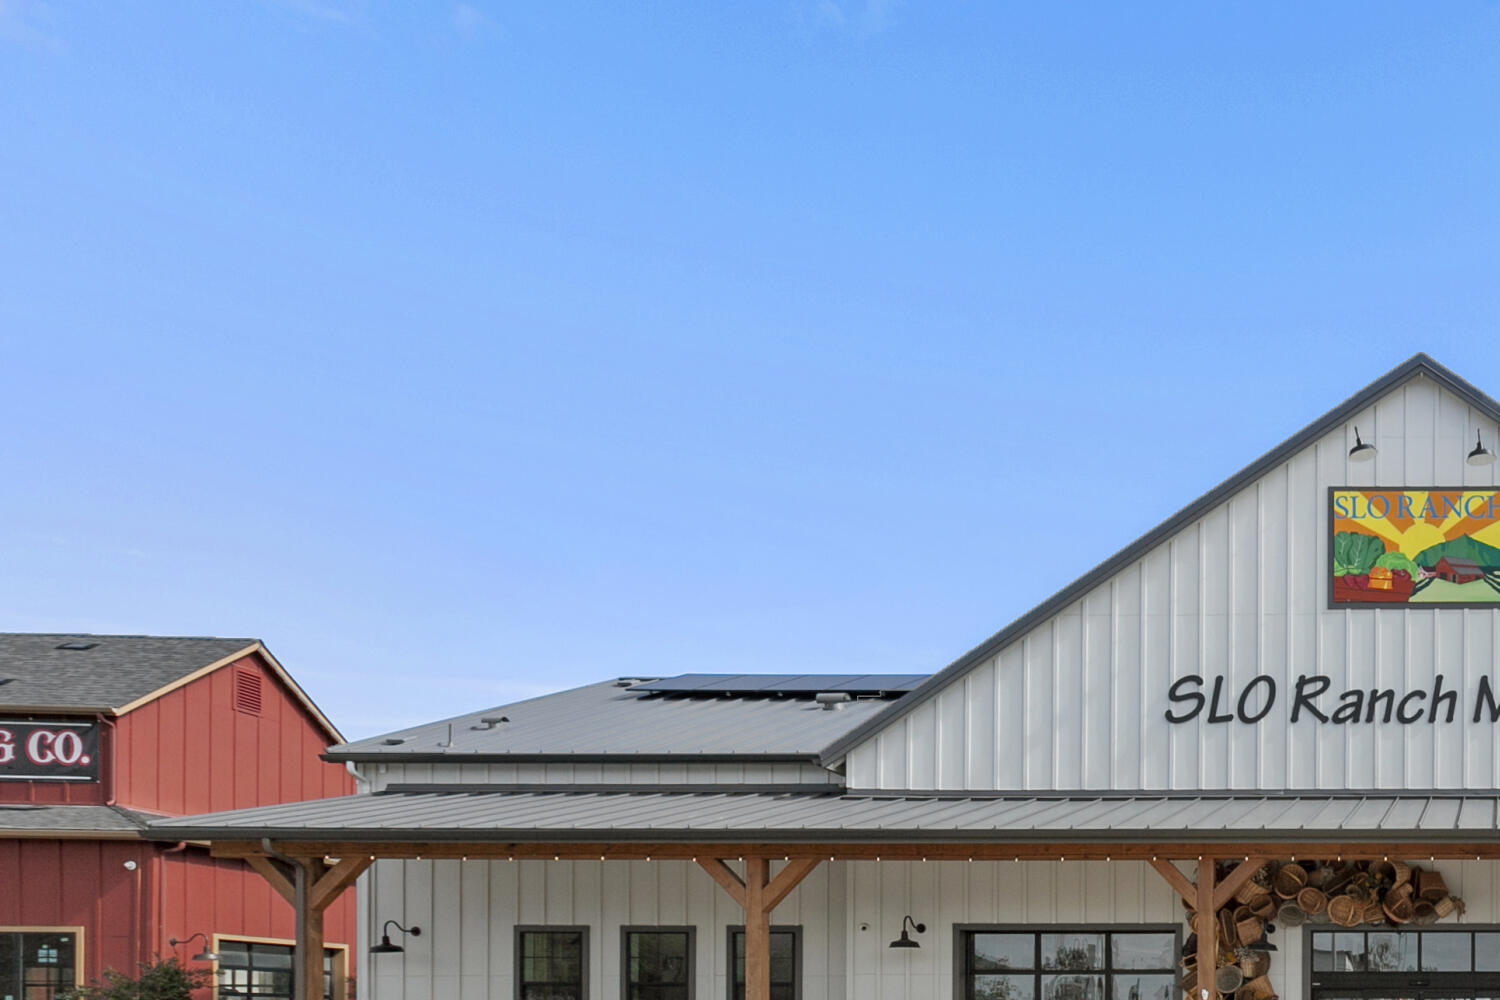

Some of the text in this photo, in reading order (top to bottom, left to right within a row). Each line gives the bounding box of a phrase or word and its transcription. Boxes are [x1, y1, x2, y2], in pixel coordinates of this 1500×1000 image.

[1334, 494, 1391, 520] SLO
[1165, 674, 1276, 724] SLO
[1290, 674, 1457, 724] Ranch
[26, 729, 91, 766] CO.
